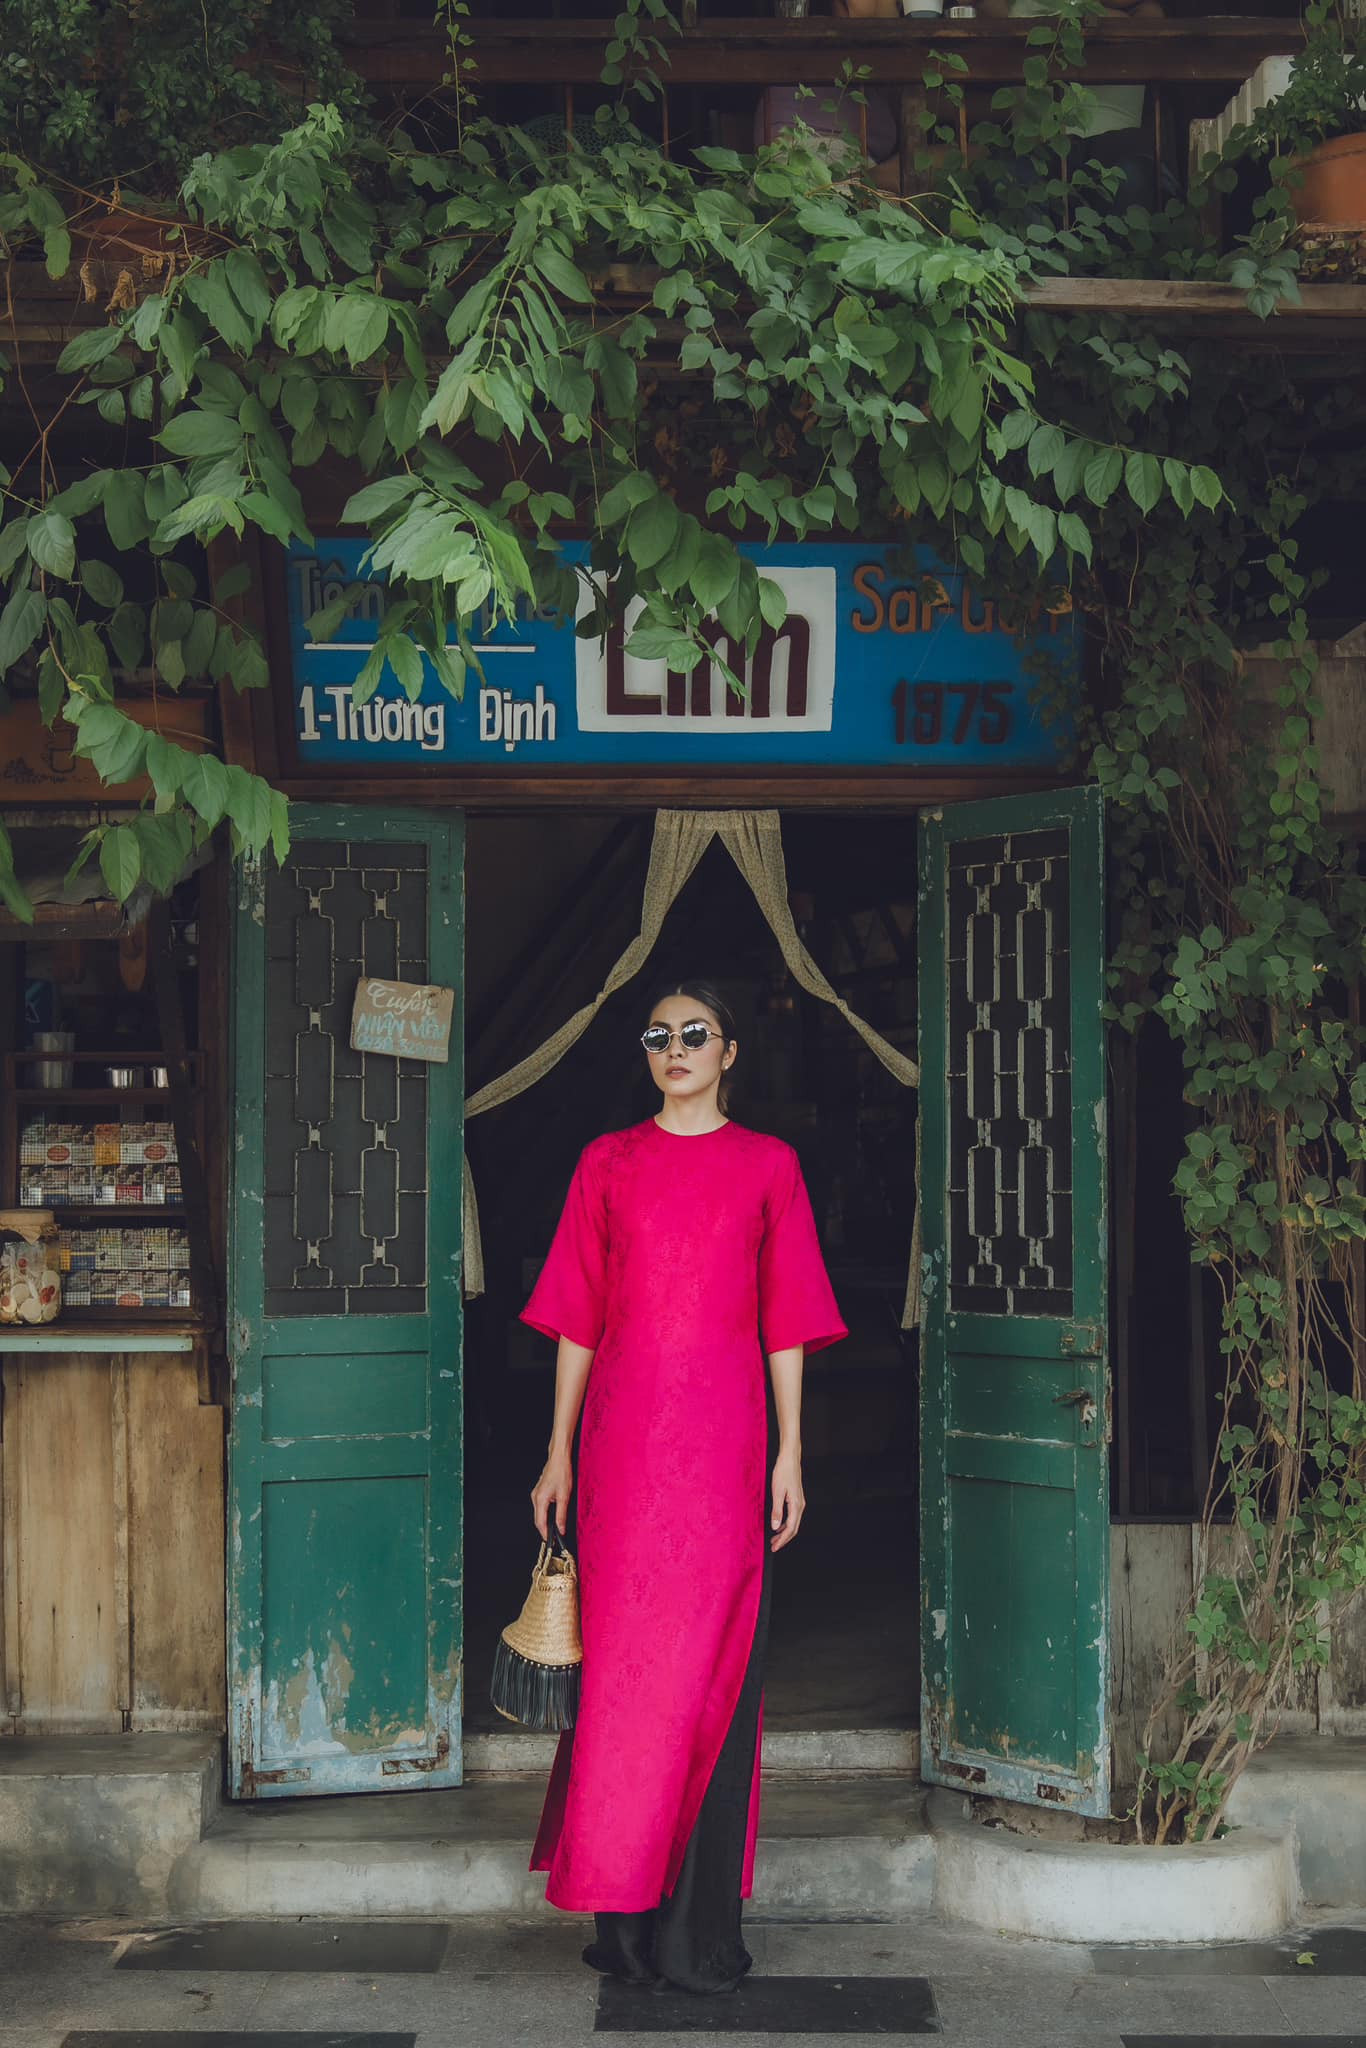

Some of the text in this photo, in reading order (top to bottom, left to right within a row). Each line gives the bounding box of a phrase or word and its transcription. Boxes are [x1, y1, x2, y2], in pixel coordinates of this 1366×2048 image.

[299, 685, 556, 752] 1-Trương Định
[892, 679, 1014, 745] 1975
